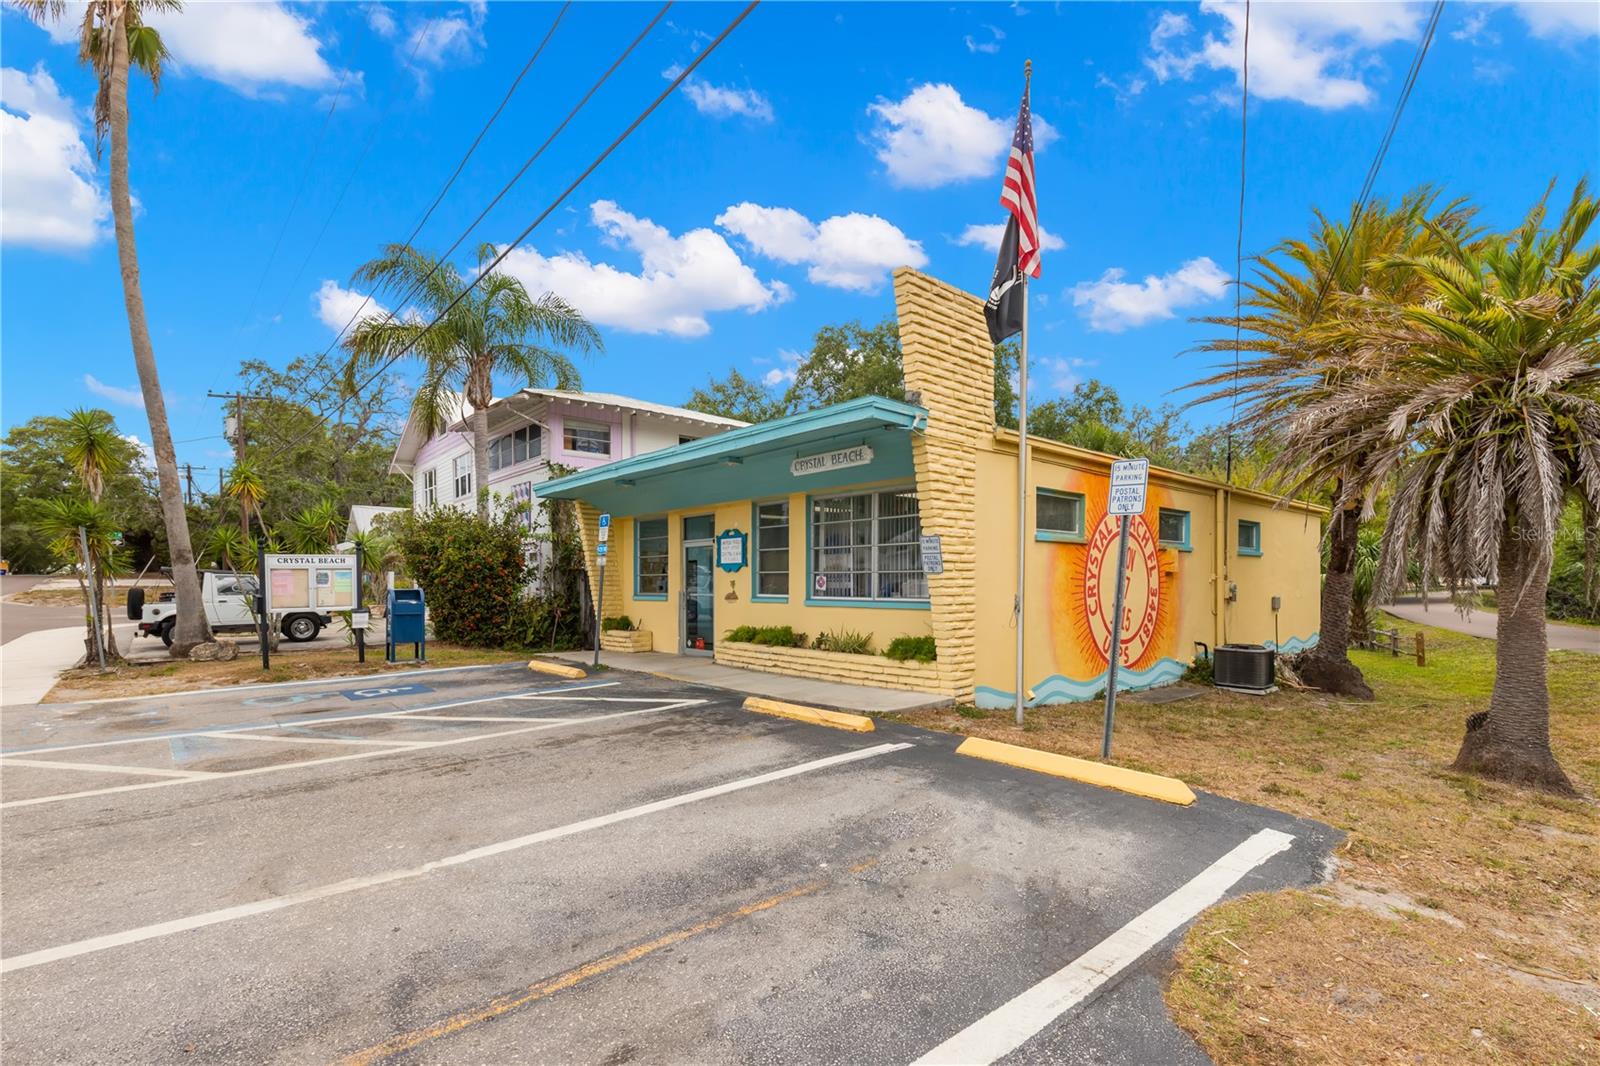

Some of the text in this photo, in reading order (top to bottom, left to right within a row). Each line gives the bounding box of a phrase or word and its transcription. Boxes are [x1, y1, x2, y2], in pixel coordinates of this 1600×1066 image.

[794, 449, 864, 472] CRYSTAL BEACH
[1122, 463, 1146, 471] MINUTE
[1115, 487, 1140, 495] POSTAL
[1112, 495, 1142, 503] PATRONS
[1087, 519, 1113, 617] CRYSTAL
[1147, 550, 1157, 577] FL
